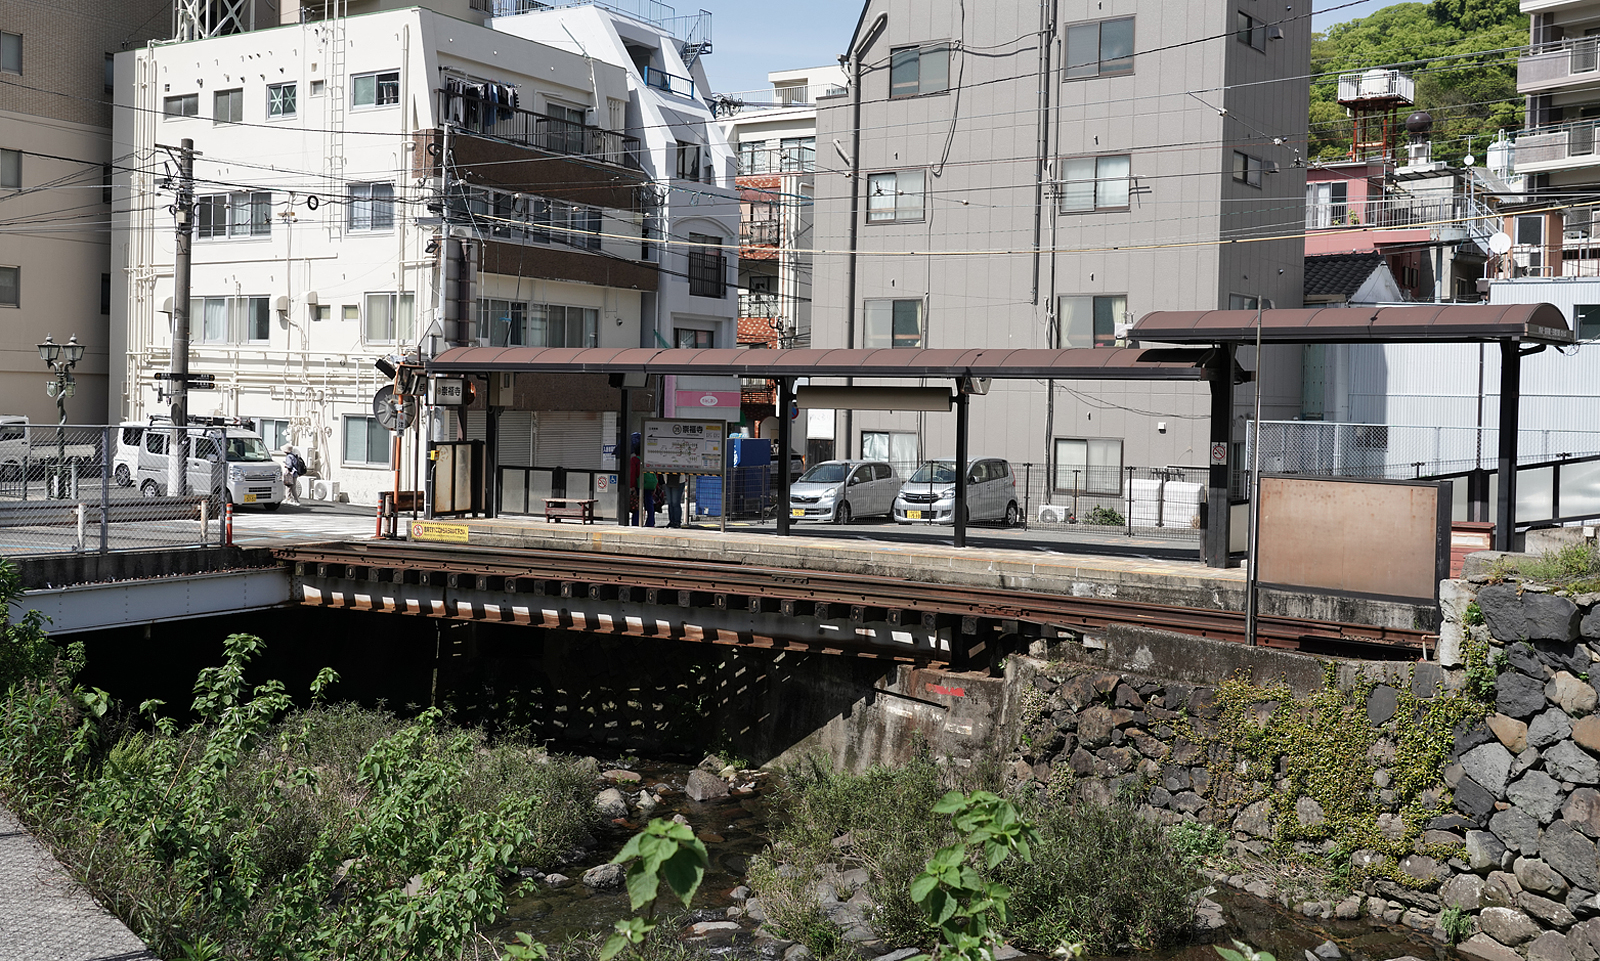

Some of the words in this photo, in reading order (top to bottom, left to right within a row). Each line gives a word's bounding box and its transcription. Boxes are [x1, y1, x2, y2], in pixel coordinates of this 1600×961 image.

[441, 386, 461, 396] 崇福寺
[682, 425, 703, 434] 崇福寺
